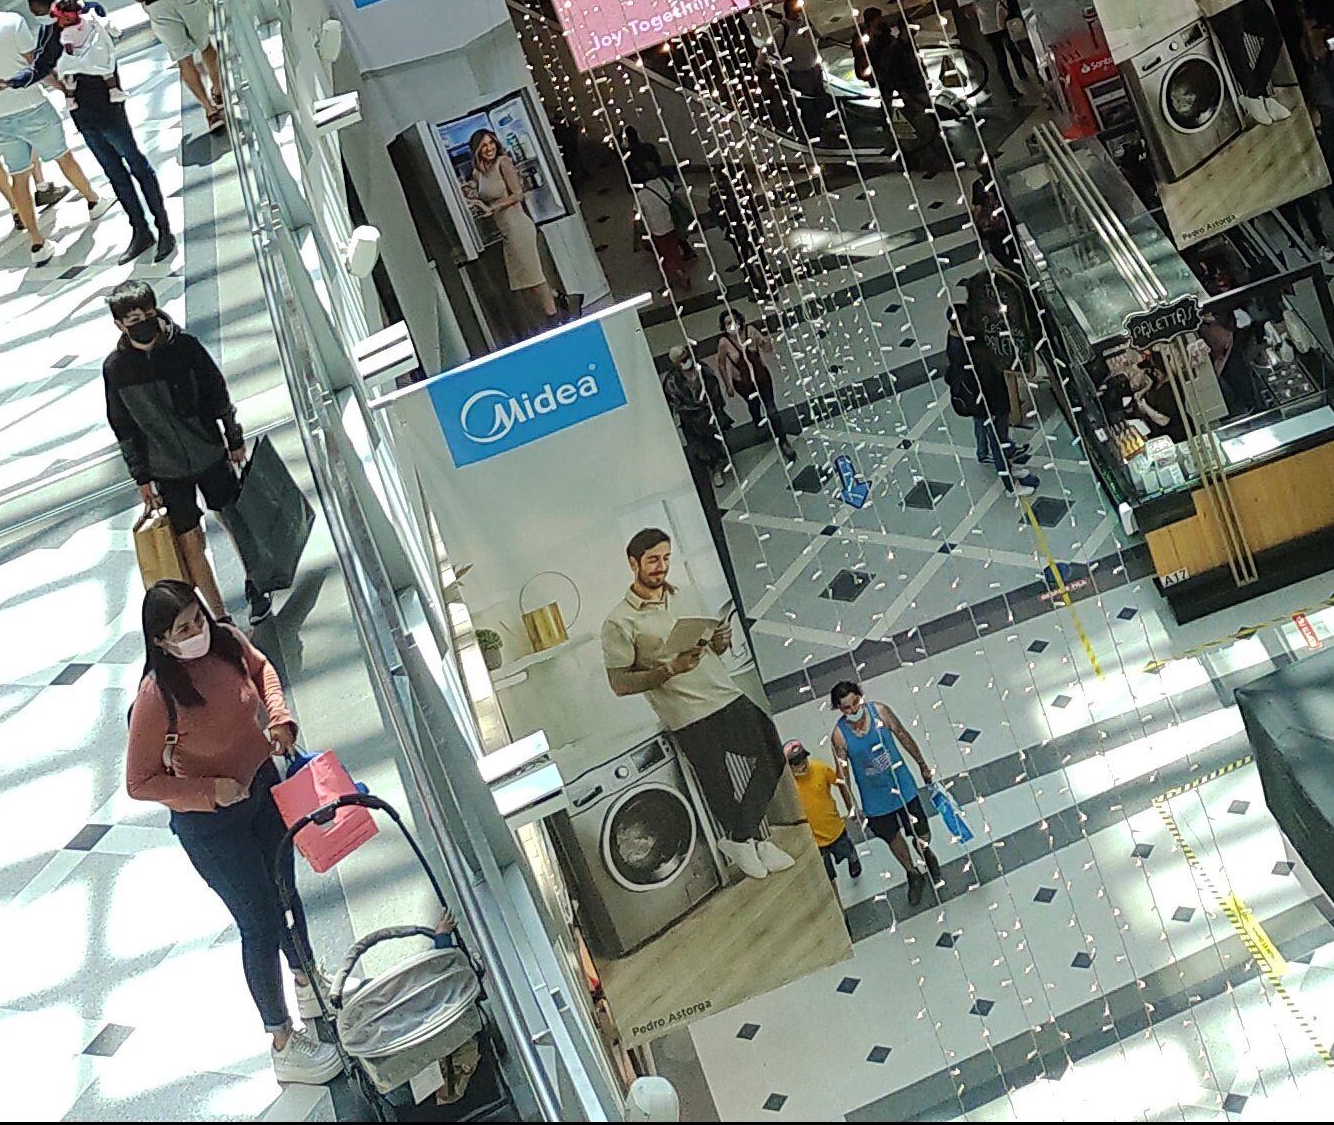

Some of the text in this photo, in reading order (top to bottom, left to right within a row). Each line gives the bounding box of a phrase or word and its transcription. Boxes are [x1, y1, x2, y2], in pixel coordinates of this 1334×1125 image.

[461, 375, 599, 444] Midea
[1165, 569, 1188, 586] A17
[631, 1000, 713, 1038] Pedro Astorga
